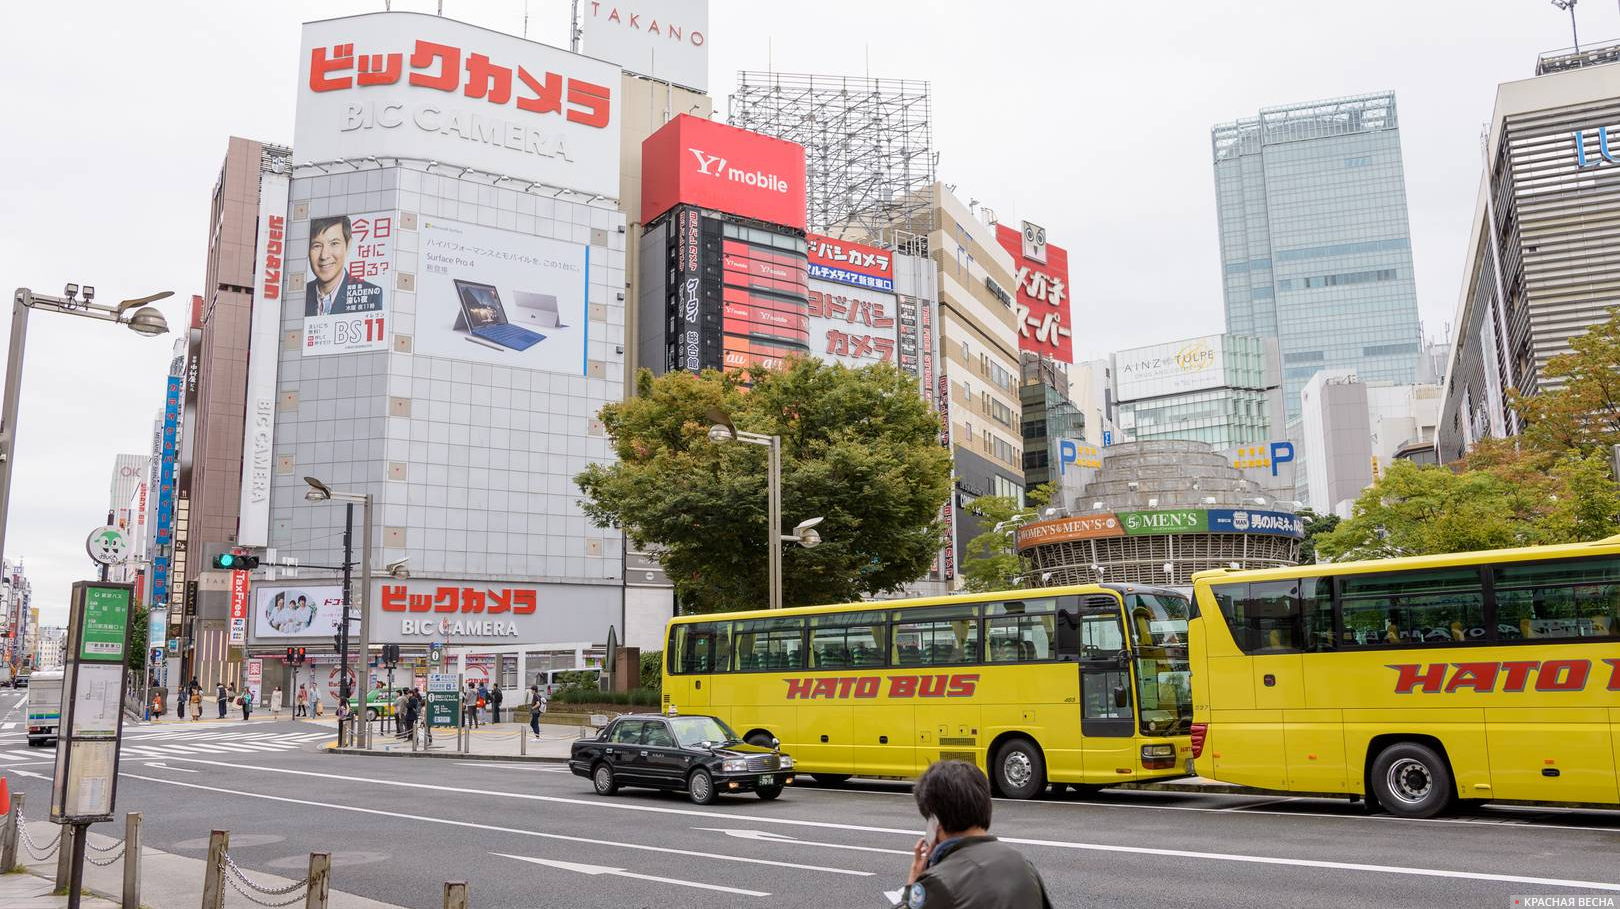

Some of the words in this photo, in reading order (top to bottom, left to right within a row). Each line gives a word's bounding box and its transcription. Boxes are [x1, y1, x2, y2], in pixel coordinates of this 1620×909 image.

[591, 1, 704, 46] TAKANO
[309, 39, 611, 129] ビックカメラ
[341, 102, 403, 132] BIC
[413, 103, 575, 163] CAMERA
[350, 217, 392, 243] 今日
[264, 214, 285, 300] ビックカメラ
[357, 243, 386, 258] なに
[426, 252, 455, 264] Surface
[455, 258, 468, 267] Pro
[686, 278, 699, 323] ケータイ
[1017, 304, 1072, 347] スーパー
[726, 354, 746, 365] au
[826, 329, 894, 361] カメラ
[1124, 358, 1161, 373] AINZ
[1175, 350, 1215, 365] TULPE
[256, 399, 270, 427] BIC
[1060, 440, 1077, 475] P
[1270, 441, 1294, 477] P
[1142, 512, 1198, 527] MEN'S
[381, 585, 537, 615] ビックカメラ
[402, 619, 434, 636] BIC
[438, 619, 519, 637] CAMERA
[785, 676, 882, 700] HATO
[887, 673, 981, 699] BUS
[1384, 658, 1593, 694] HATO
